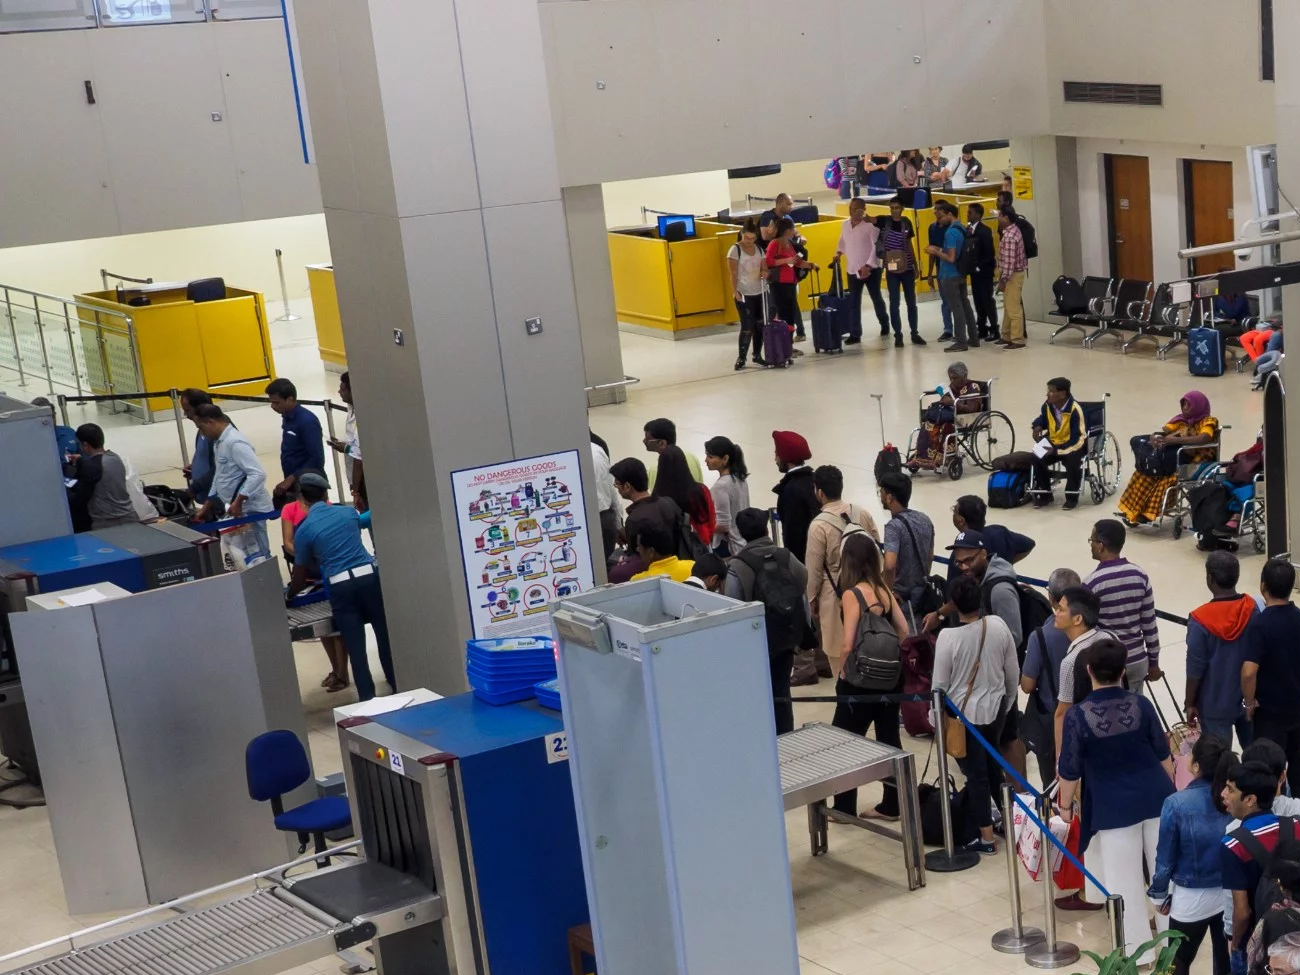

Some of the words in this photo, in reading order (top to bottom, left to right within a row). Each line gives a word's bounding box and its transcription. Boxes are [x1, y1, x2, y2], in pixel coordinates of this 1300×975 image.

[487, 466, 530, 480] DANGEROUS
[531, 461, 557, 471] GOODS
[157, 568, 190, 580] smiths
[391, 753, 402, 768] 21
